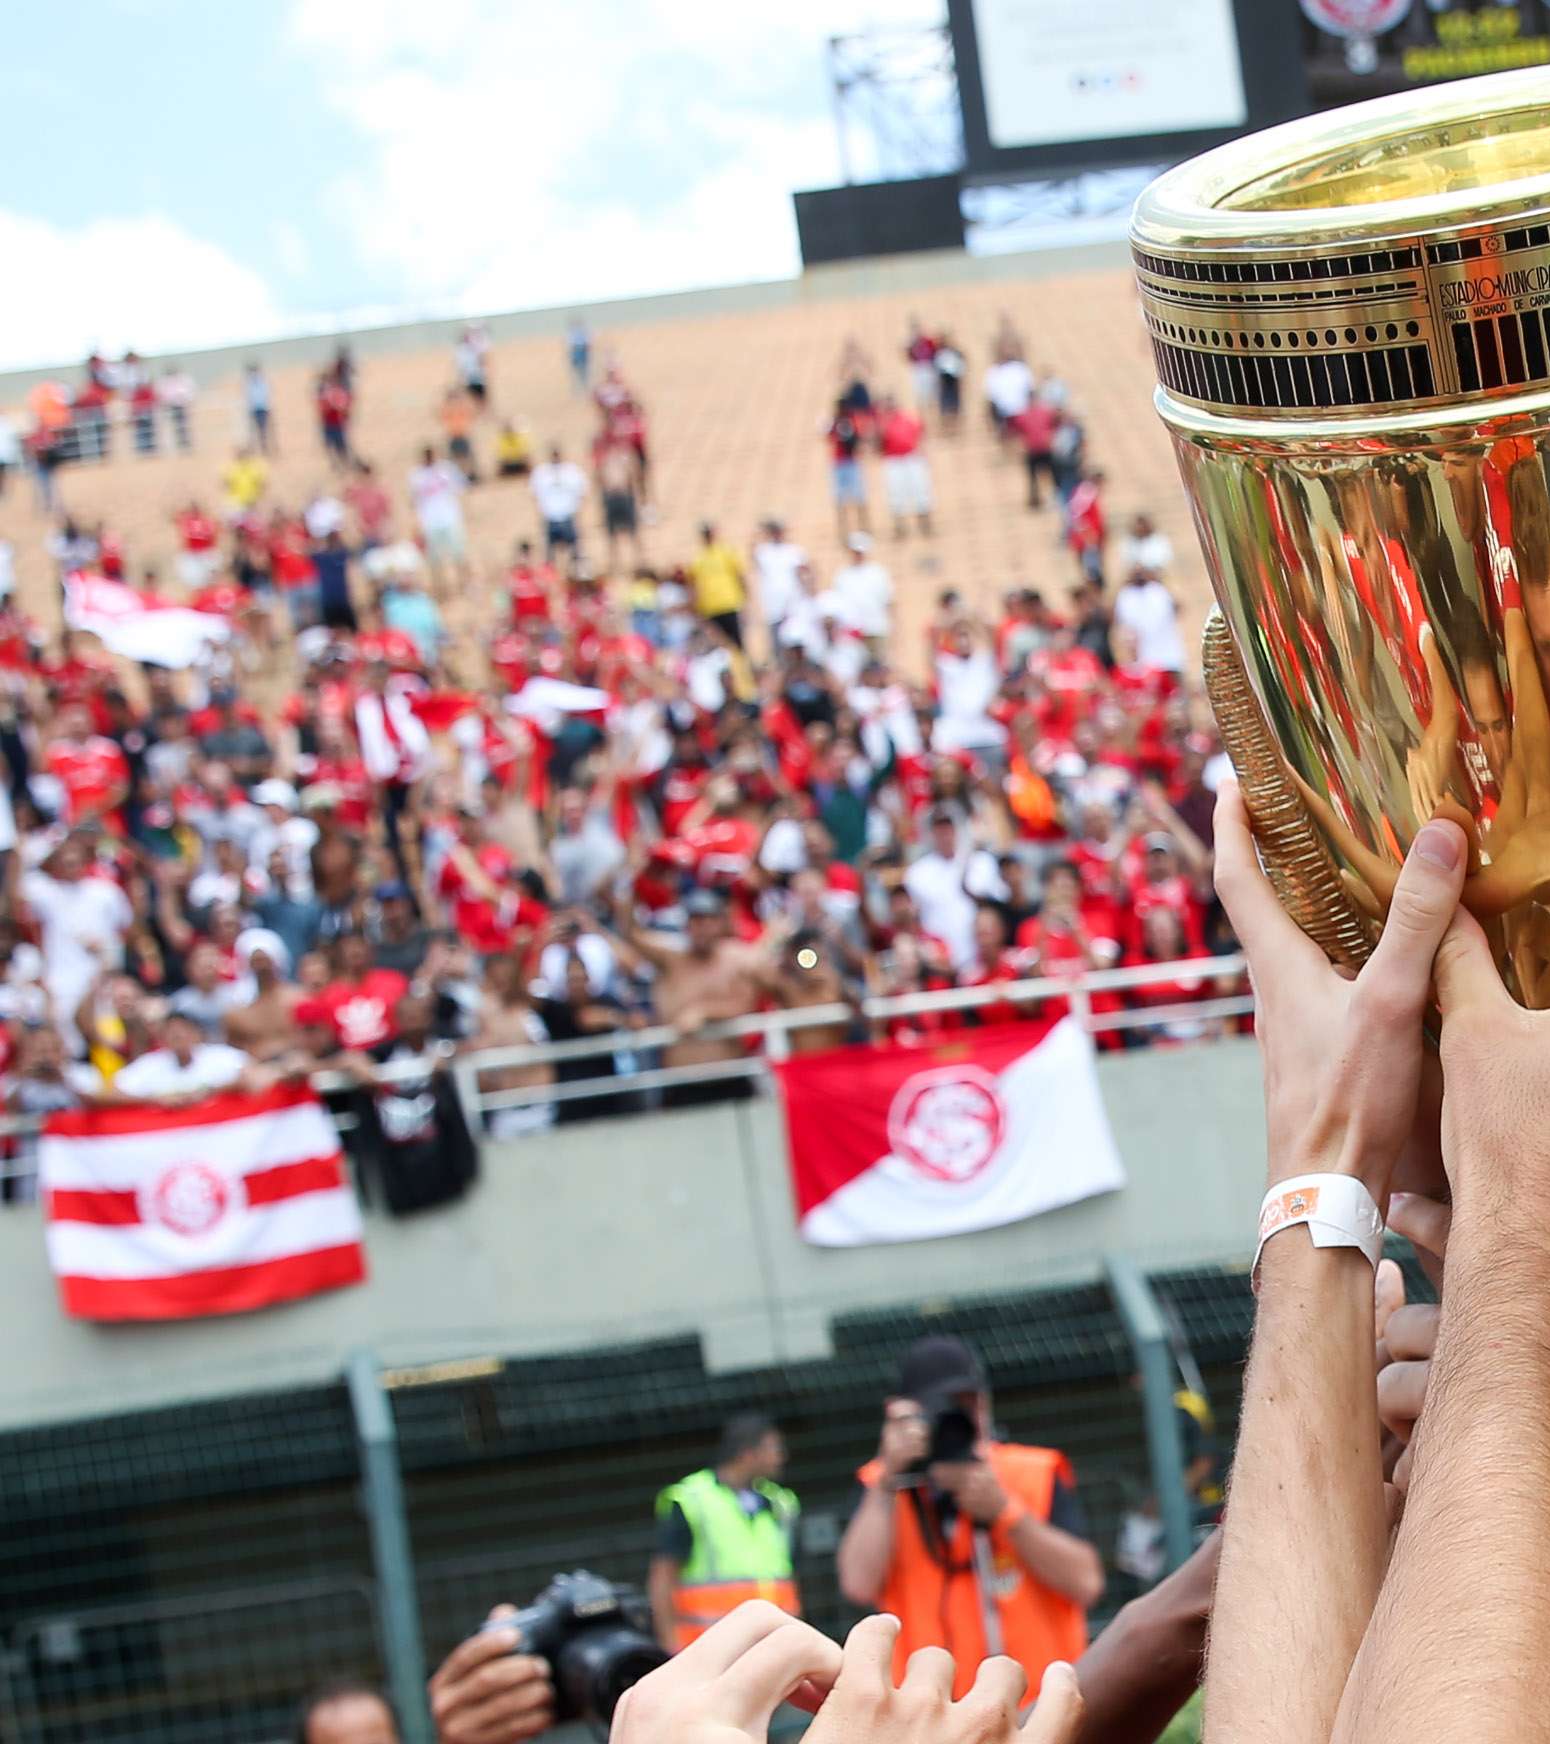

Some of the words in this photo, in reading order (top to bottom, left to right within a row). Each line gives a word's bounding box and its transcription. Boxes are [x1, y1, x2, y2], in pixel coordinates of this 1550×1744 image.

[1445, 309, 1467, 321] PAULO
[1473, 302, 1507, 317] MACHADO
[1514, 299, 1524, 311] DE
